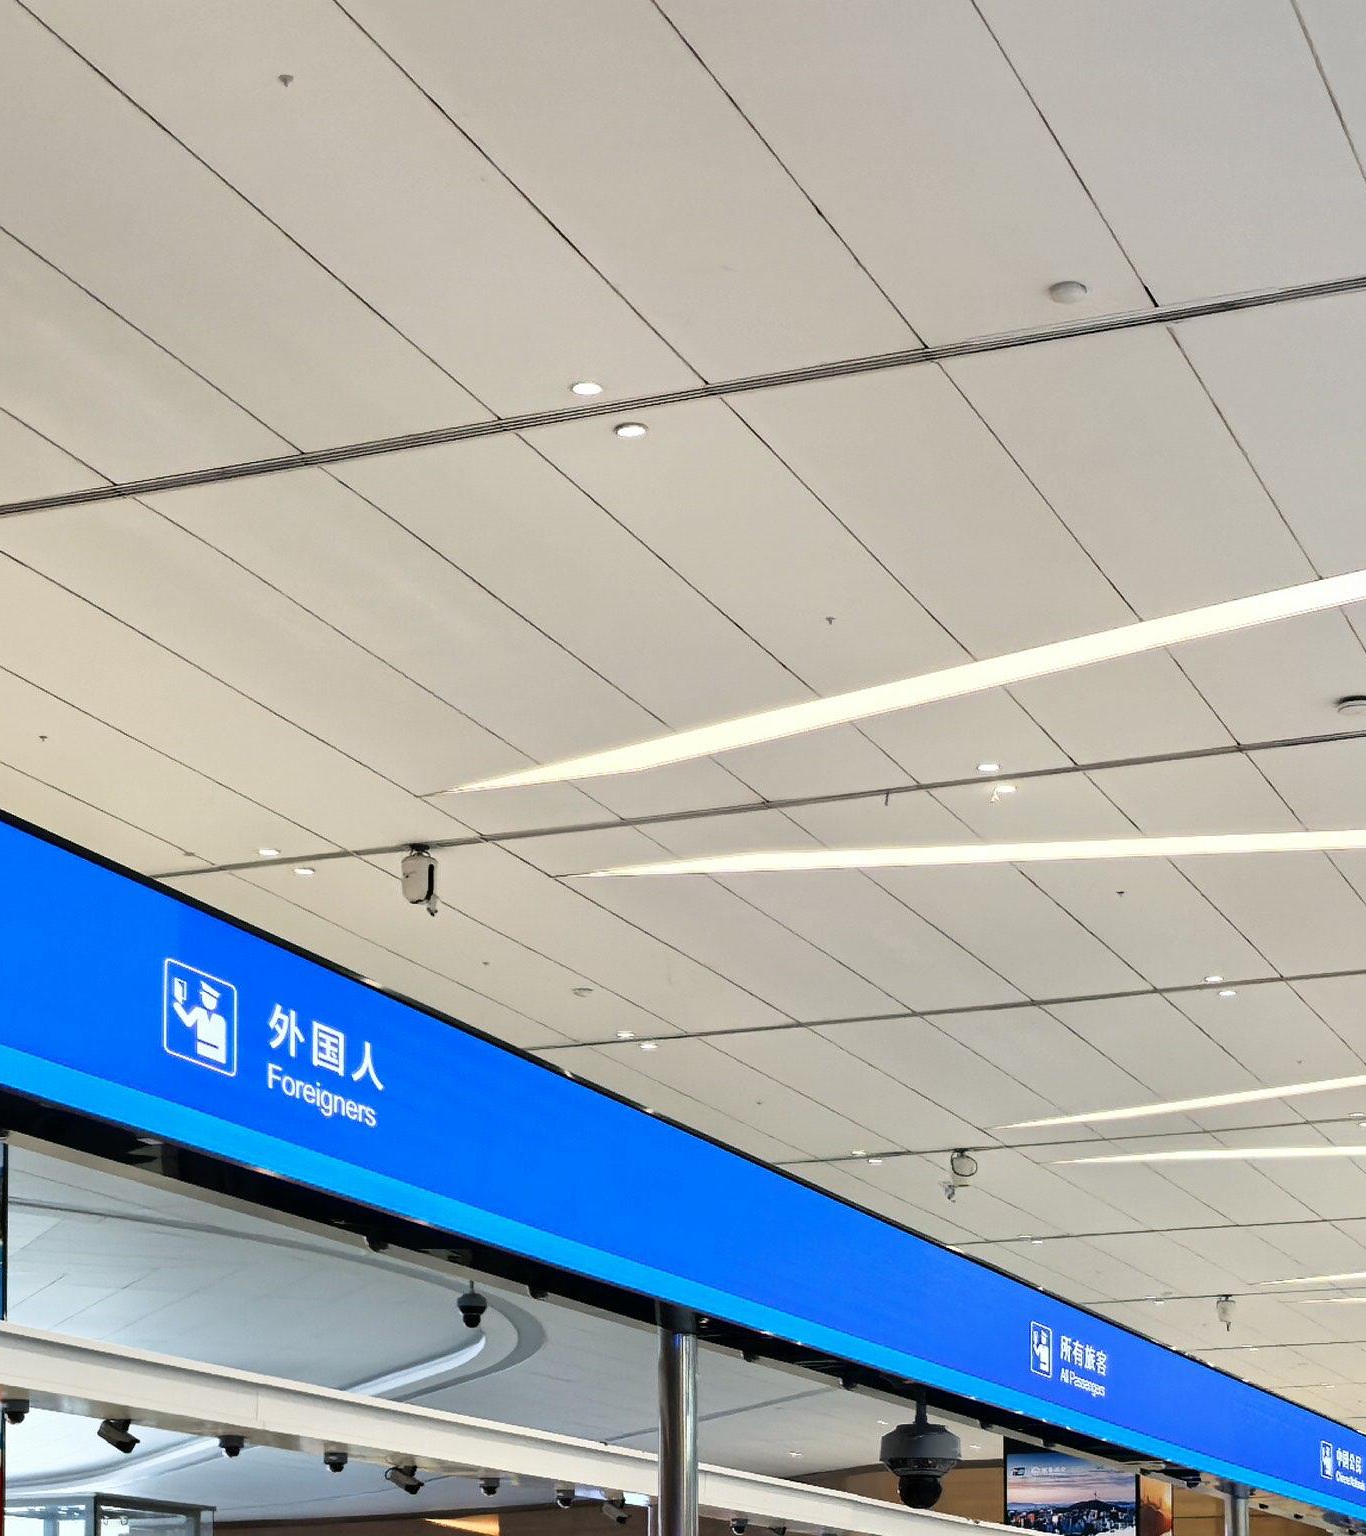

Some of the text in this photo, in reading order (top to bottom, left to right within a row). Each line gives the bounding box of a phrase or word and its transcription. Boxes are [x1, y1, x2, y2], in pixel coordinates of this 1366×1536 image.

[268, 1003, 384, 1091] 外国人
[267, 1063, 377, 1127] Foreigners
[1060, 1335, 1107, 1376] 所有旅客
